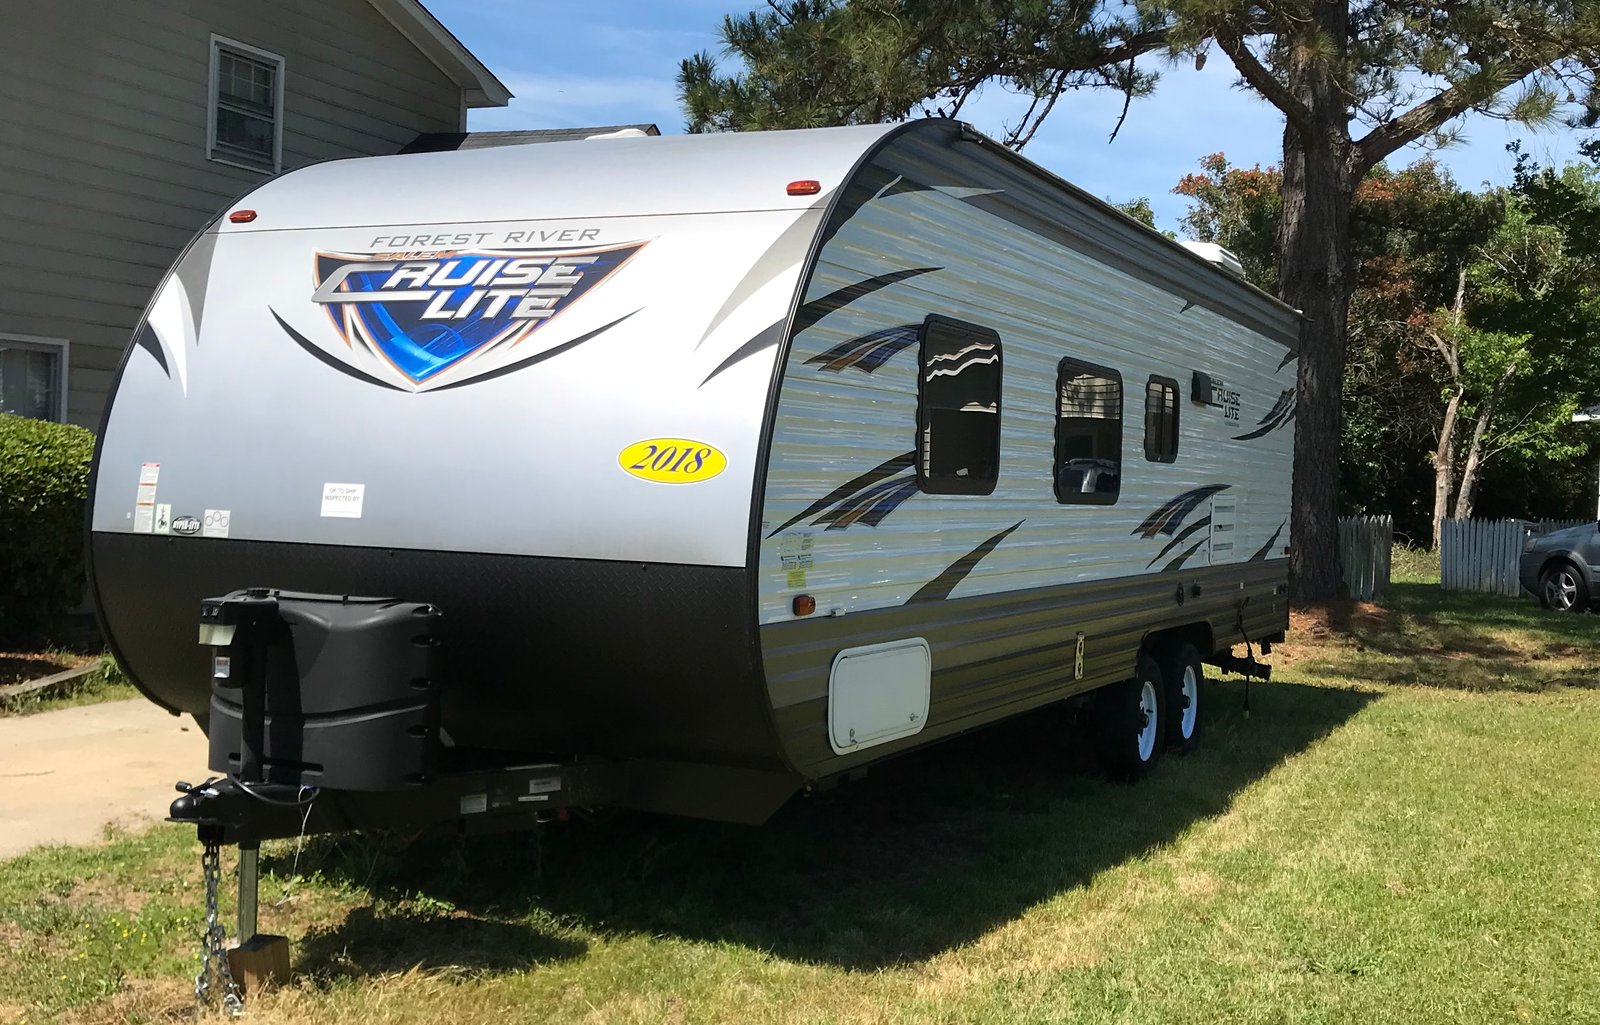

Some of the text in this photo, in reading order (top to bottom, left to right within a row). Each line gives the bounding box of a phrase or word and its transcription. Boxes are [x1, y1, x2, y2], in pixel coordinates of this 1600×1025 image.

[370, 228, 601, 248] FOREST RIVER
[373, 249, 458, 261] SALEM
[311, 256, 600, 303] CRUISE
[419, 287, 573, 321] LITE
[1224, 405, 1239, 420] LITE
[629, 444, 712, 474] 2018
